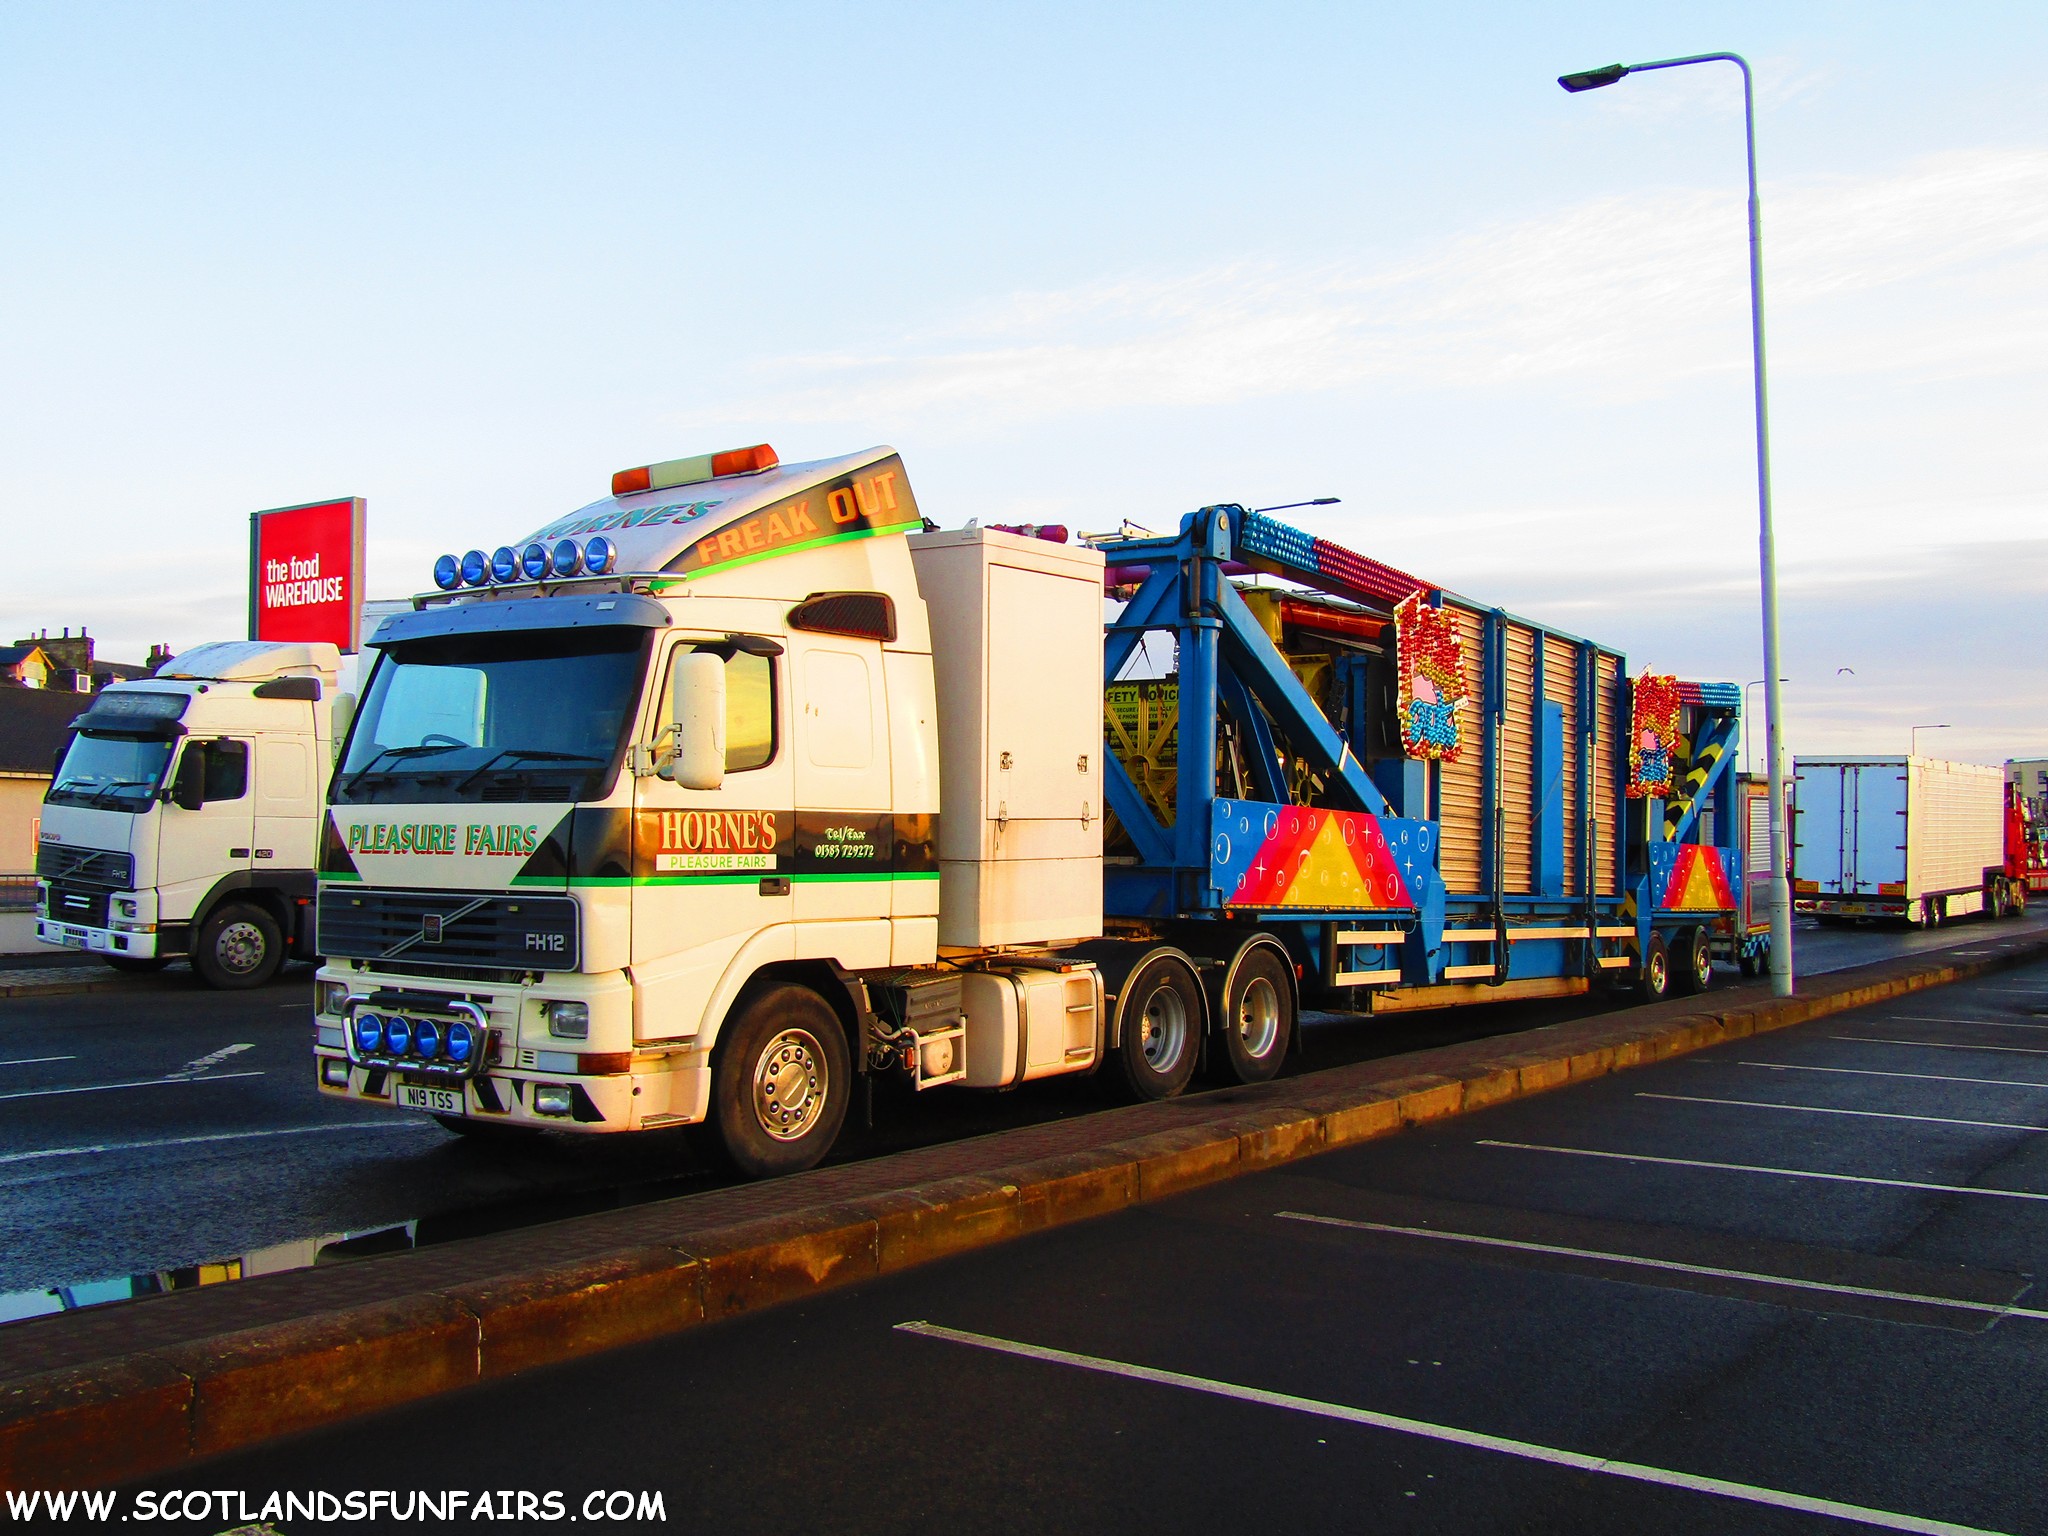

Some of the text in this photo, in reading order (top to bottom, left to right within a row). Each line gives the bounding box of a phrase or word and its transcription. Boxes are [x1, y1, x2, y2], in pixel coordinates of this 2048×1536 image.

[696, 471, 897, 565] FREAK OUT
[266, 552, 320, 583] the food
[265, 576, 344, 609] WAREHOUSE
[1107, 691, 1137, 703] FETY
[349, 824, 539, 857] PLEASURE FAIRS
[659, 810, 777, 852] HORNE'S
[256, 850, 272, 858] 420
[670, 855, 767, 869] PLEASURE FAIRS
[815, 844, 875, 859] 01383 729272
[525, 933, 565, 951] FH12
[407, 1087, 454, 1110] N19 TSS
